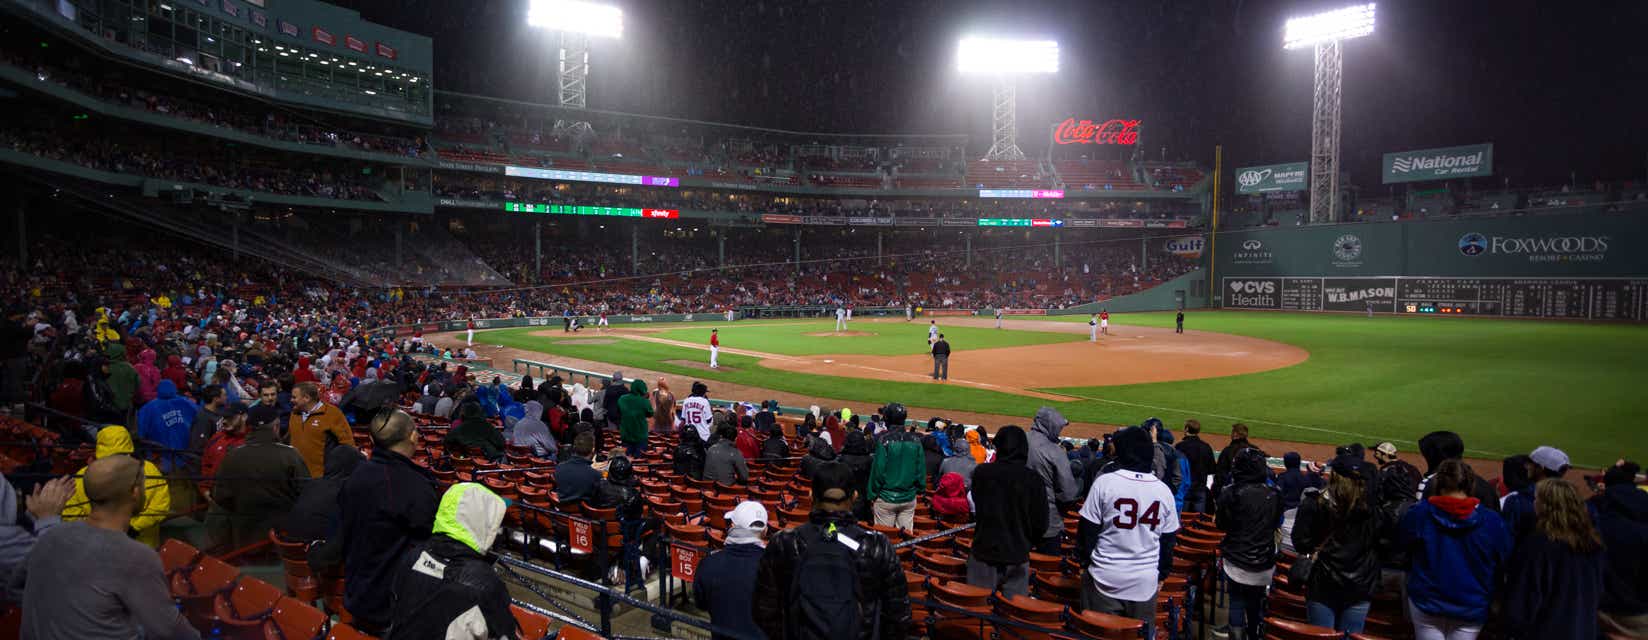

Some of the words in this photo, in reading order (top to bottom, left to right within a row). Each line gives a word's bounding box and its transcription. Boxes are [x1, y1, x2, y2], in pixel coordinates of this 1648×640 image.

[1055, 117, 1143, 144] Coca-Cola
[1411, 152, 1482, 170] National
[1167, 240, 1203, 251] Gulf
[1492, 236, 1608, 254] FOXWOODS
[1244, 281, 1274, 293] CVS
[1231, 294, 1274, 306] Health
[687, 411, 701, 424] 15
[1113, 498, 1160, 531] 34
[576, 534, 588, 547] 16
[680, 562, 693, 575] 15
